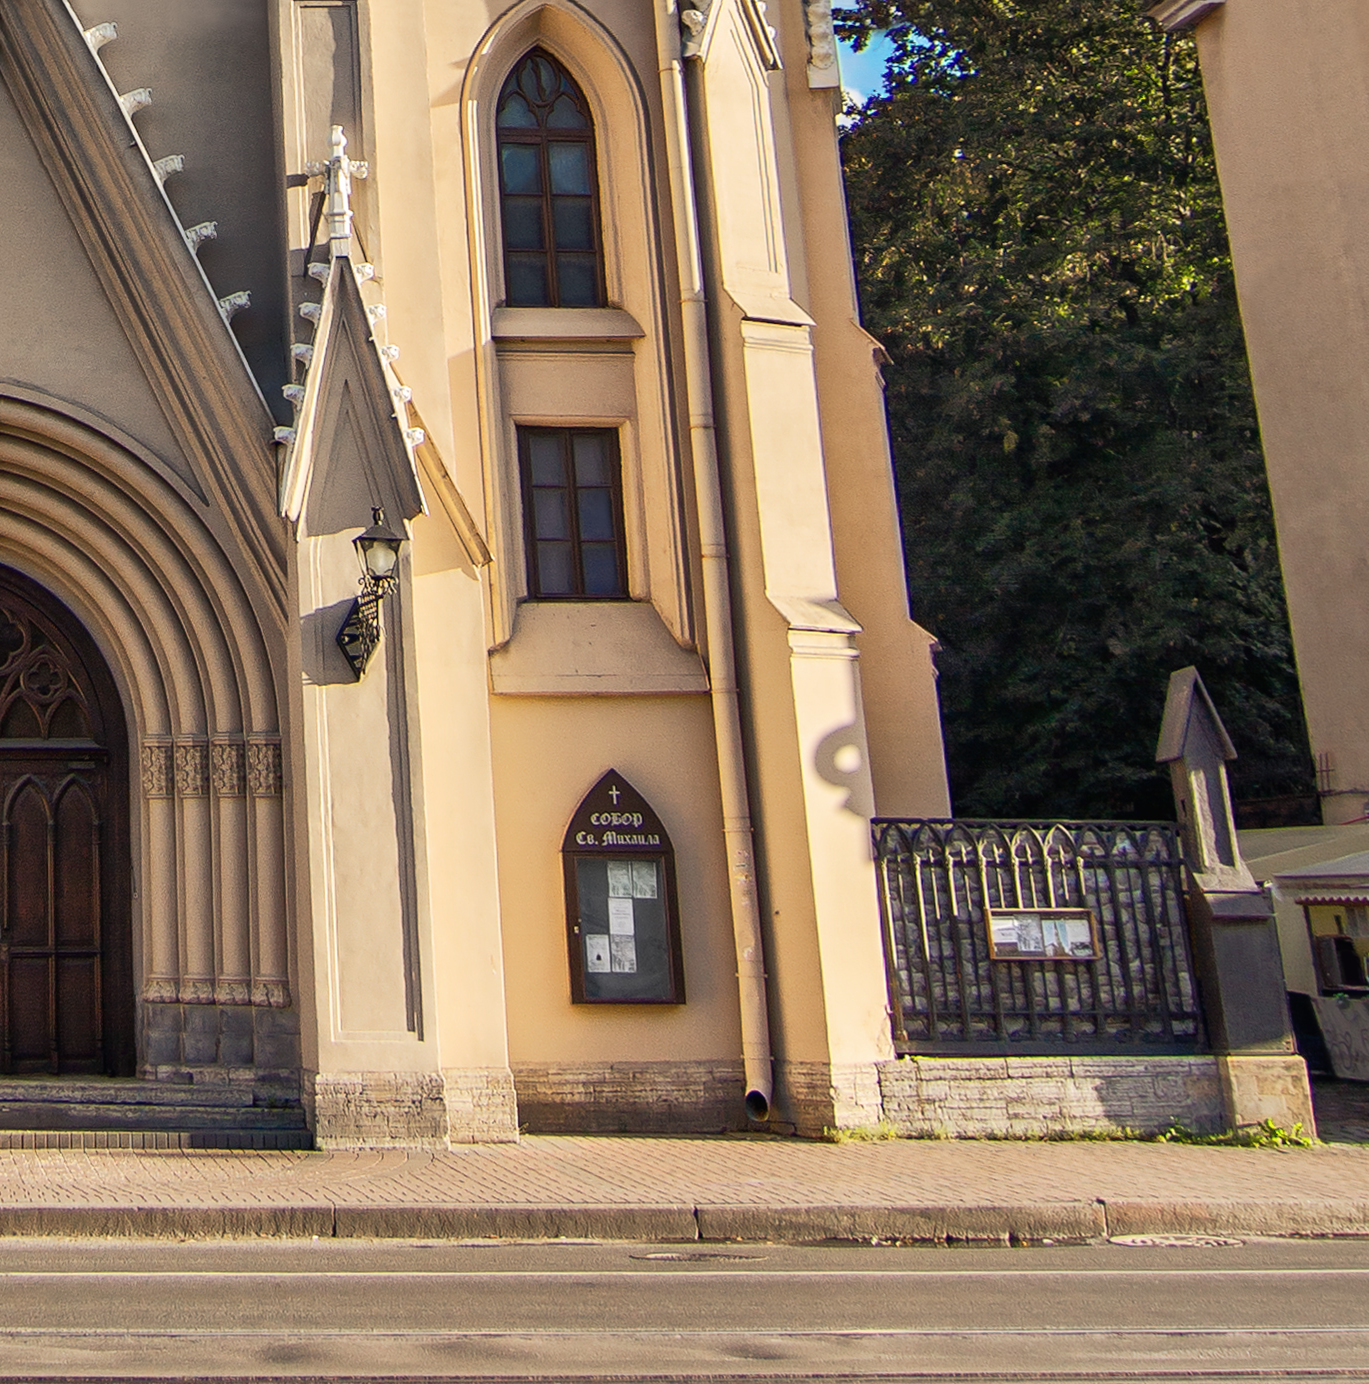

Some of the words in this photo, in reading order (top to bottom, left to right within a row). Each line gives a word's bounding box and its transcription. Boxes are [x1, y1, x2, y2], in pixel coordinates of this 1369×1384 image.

[590, 812, 643, 828] СОБОР
[575, 831, 599, 845] Св.
[601, 831, 661, 846] Михаила
